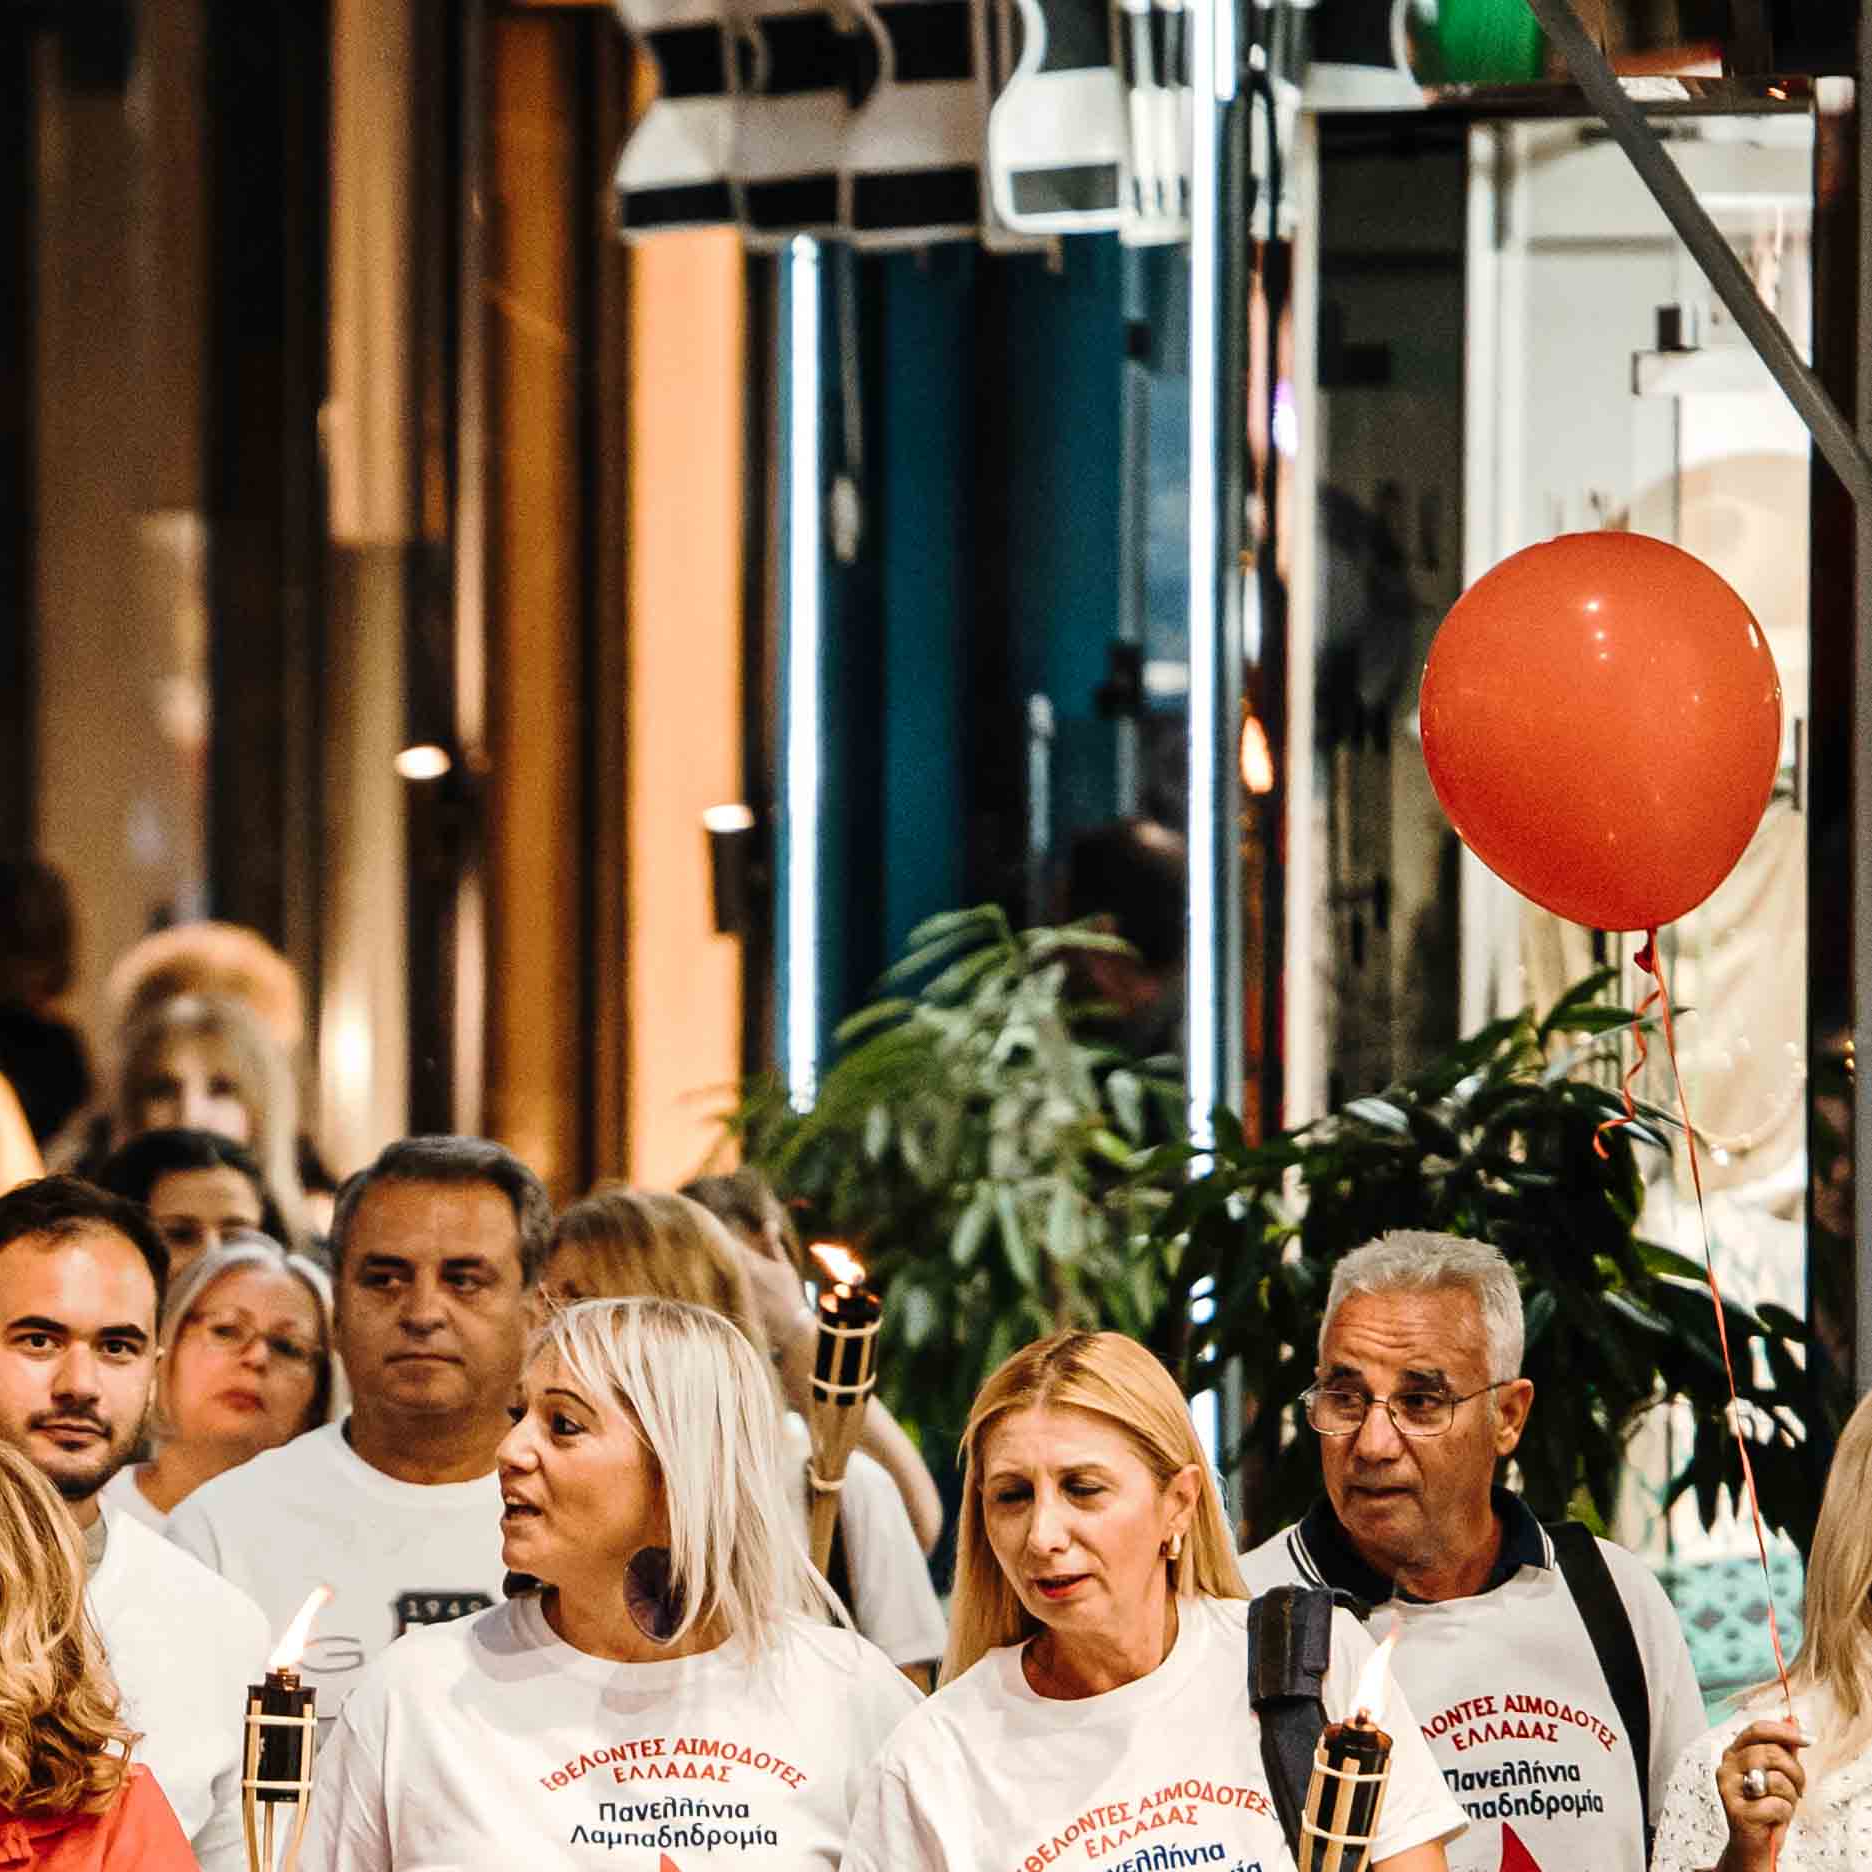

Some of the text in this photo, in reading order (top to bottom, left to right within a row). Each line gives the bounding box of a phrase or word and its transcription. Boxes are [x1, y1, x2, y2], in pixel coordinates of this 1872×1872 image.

[1421, 1694, 1618, 1752] ΛΟΝΤΕΣ ΑΙΜΟΔΟΤΕΣ
[1452, 1718, 1559, 1751] ΕΛΛΑΔΑΣ
[539, 1737, 807, 1792] ΕΘΕΛΟΝΤΕΣ ΑΙΜΟΔΟΤΕΣ
[613, 1762, 733, 1785] ΕΛΛΑΔΑΣ
[1443, 1760, 1581, 1793] Πανελλήνια
[598, 1796, 749, 1823] Πανελλήνια
[1139, 1778, 1272, 1815] ΑΙΜΟΔΟΤΕΣ
[1462, 1789, 1604, 1821] παδηδρομία
[570, 1823, 778, 1852] Λαμπαδηδρομία
[1084, 1804, 1199, 1860] ΕΛΛΑΔΑΣ
